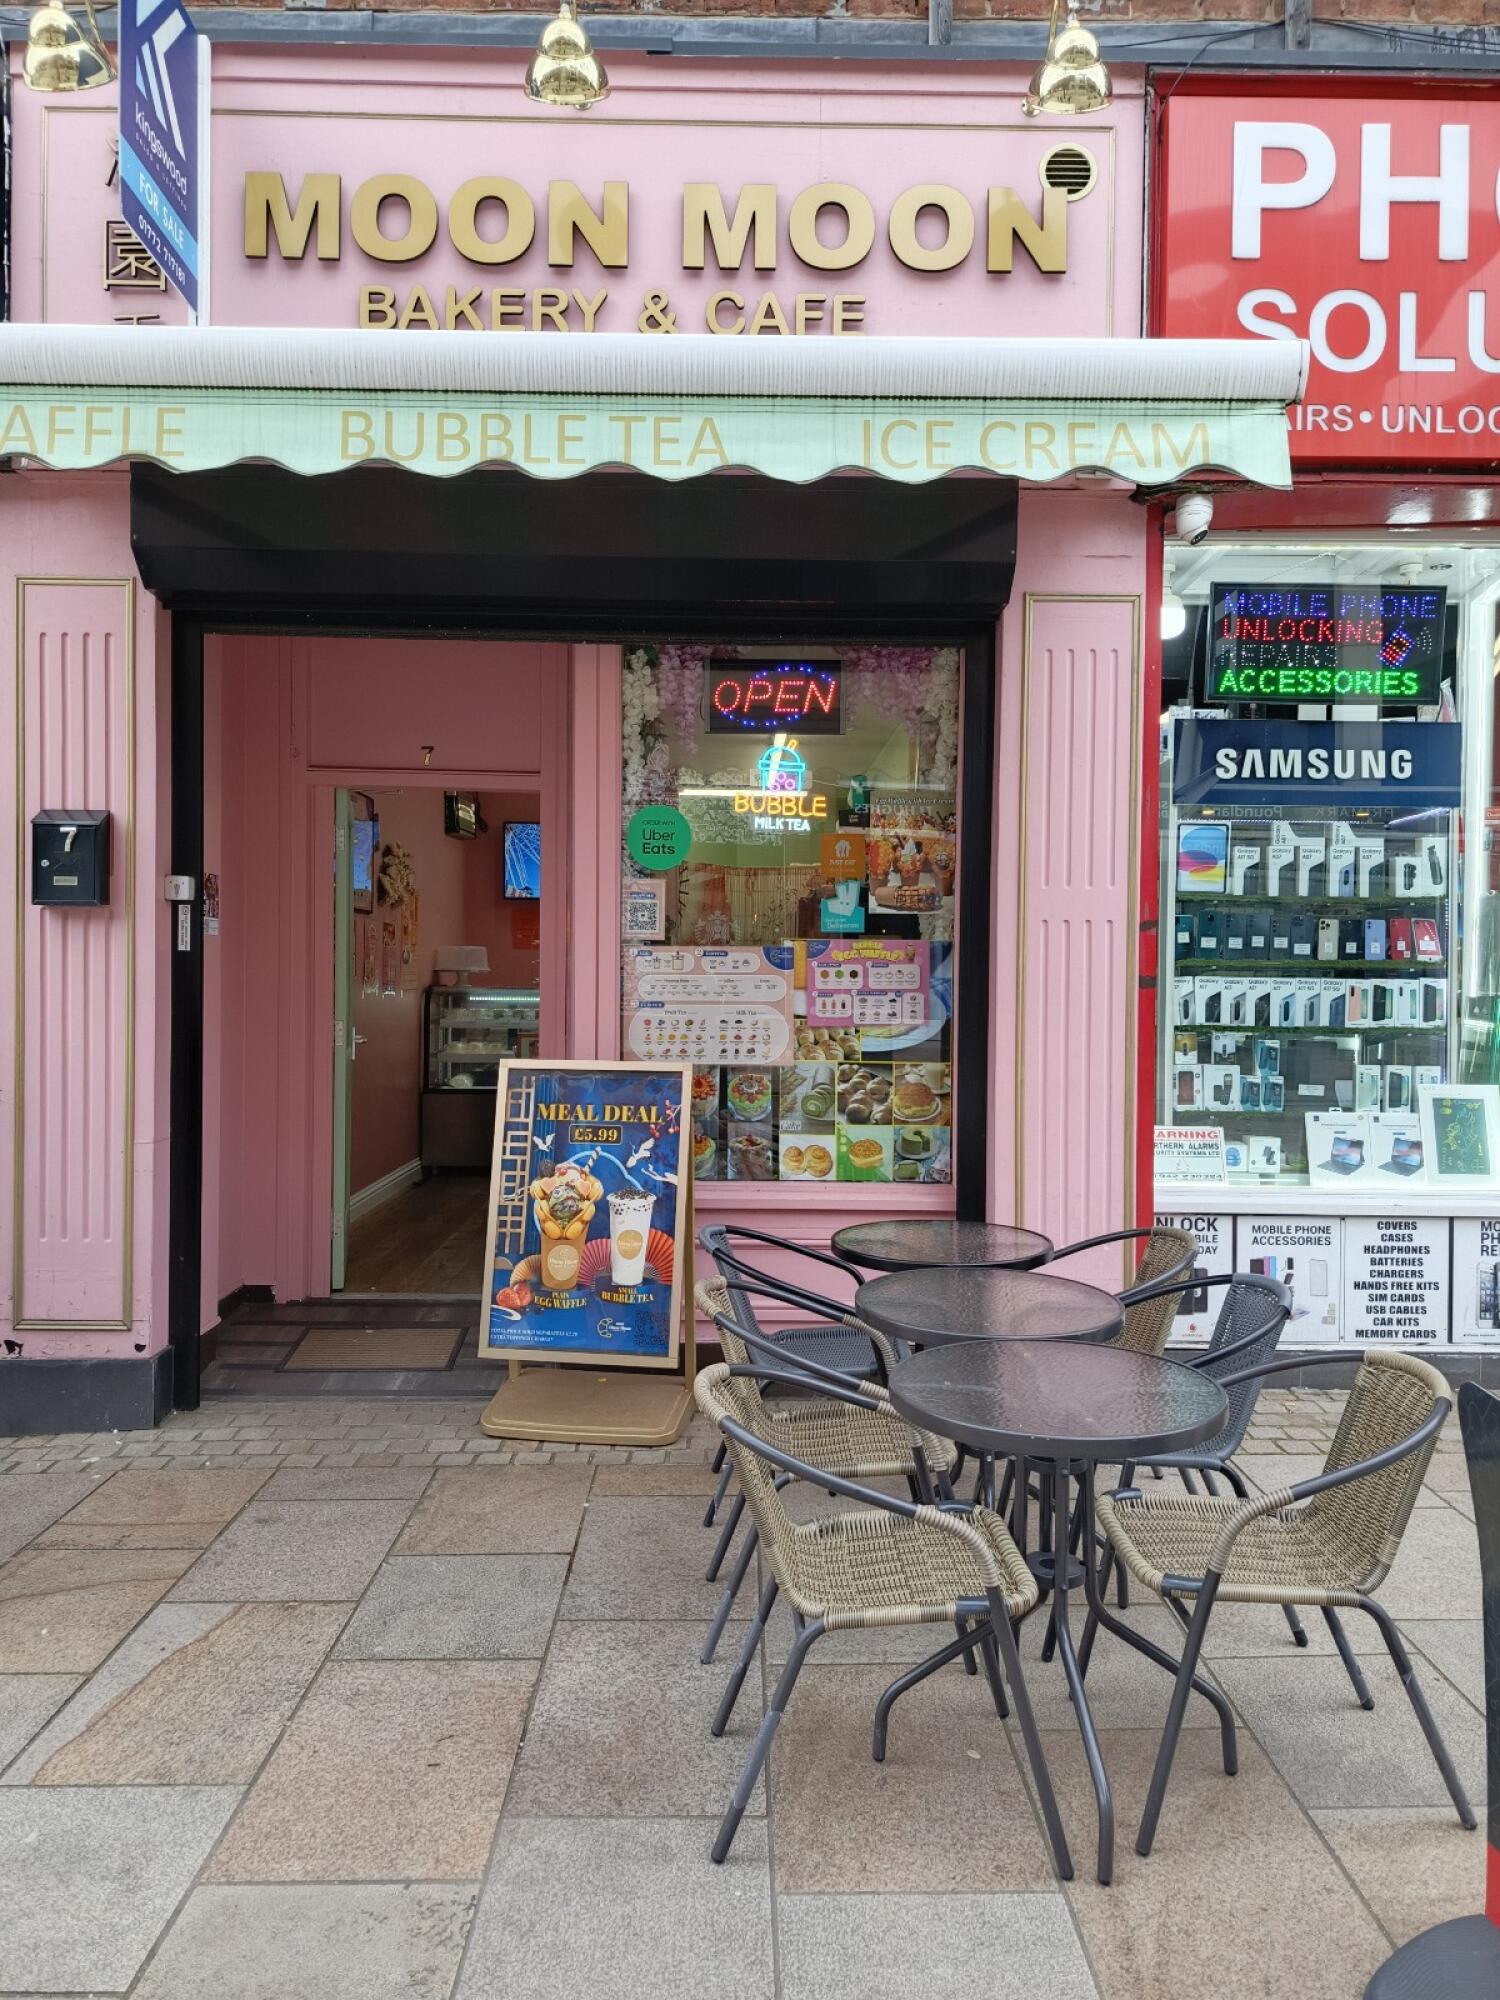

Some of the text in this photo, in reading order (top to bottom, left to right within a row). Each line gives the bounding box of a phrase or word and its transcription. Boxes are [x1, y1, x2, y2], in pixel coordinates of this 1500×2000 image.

[135, 102, 188, 196] kingswood
[1232, 121, 1500, 262] PH
[139, 172, 184, 251] FOR SALE
[243, 171, 1068, 274] MOON MOON
[359, 284, 866, 336] BAKERY & CAFE
[1287, 404, 1354, 432] IRS
[0, 405, 1210, 470] AFFLE BUBBLE TEA ICE CREAM
[1223, 592, 1438, 618] MOBILE PHONE
[1223, 618, 1385, 643] UNLOCKING
[1219, 644, 1338, 667] REPAIRS
[1219, 669, 1419, 695] ACCESSORIES
[714, 680, 837, 714] OPEN
[421, 745, 434, 766] 7
[1215, 747, 1413, 780] SAMSUNG
[734, 793, 828, 817] BUBBLE
[786, 818, 811, 832] TEA
[60, 826, 77, 852] 7
[642, 828, 676, 842] Uber
[642, 842, 676, 855] Eats
[537, 1103, 664, 1124] MEAL DEAL
[573, 1128, 619, 1142] £5.99
[1154, 1130, 1219, 1139] ARNING
[1188, 1142, 1220, 1150] ALARMS
[1252, 1225, 1332, 1235] MOBILE PHONE
[1377, 1221, 1417, 1231] COVERS
[1252, 1236, 1332, 1246] ACCESSORIES
[1381, 1233, 1413, 1242] CASES
[1364, 1245, 1430, 1255] HEADPHONES
[1370, 1257, 1423, 1266] BATTERIES
[1370, 1269, 1424, 1279] CHARGERS
[1354, 1281, 1439, 1291] HANDS FREE KITS
[534, 1296, 587, 1309] EGG WAFFLE
[602, 1291, 654, 1303] BUBBLE TEA
[1368, 1293, 1425, 1303] SIM CARDS
[1366, 1305, 1427, 1315] USB CABLES
[1373, 1317, 1419, 1327] CAR KITS
[1355, 1329, 1437, 1339] MEMORY CARDS
